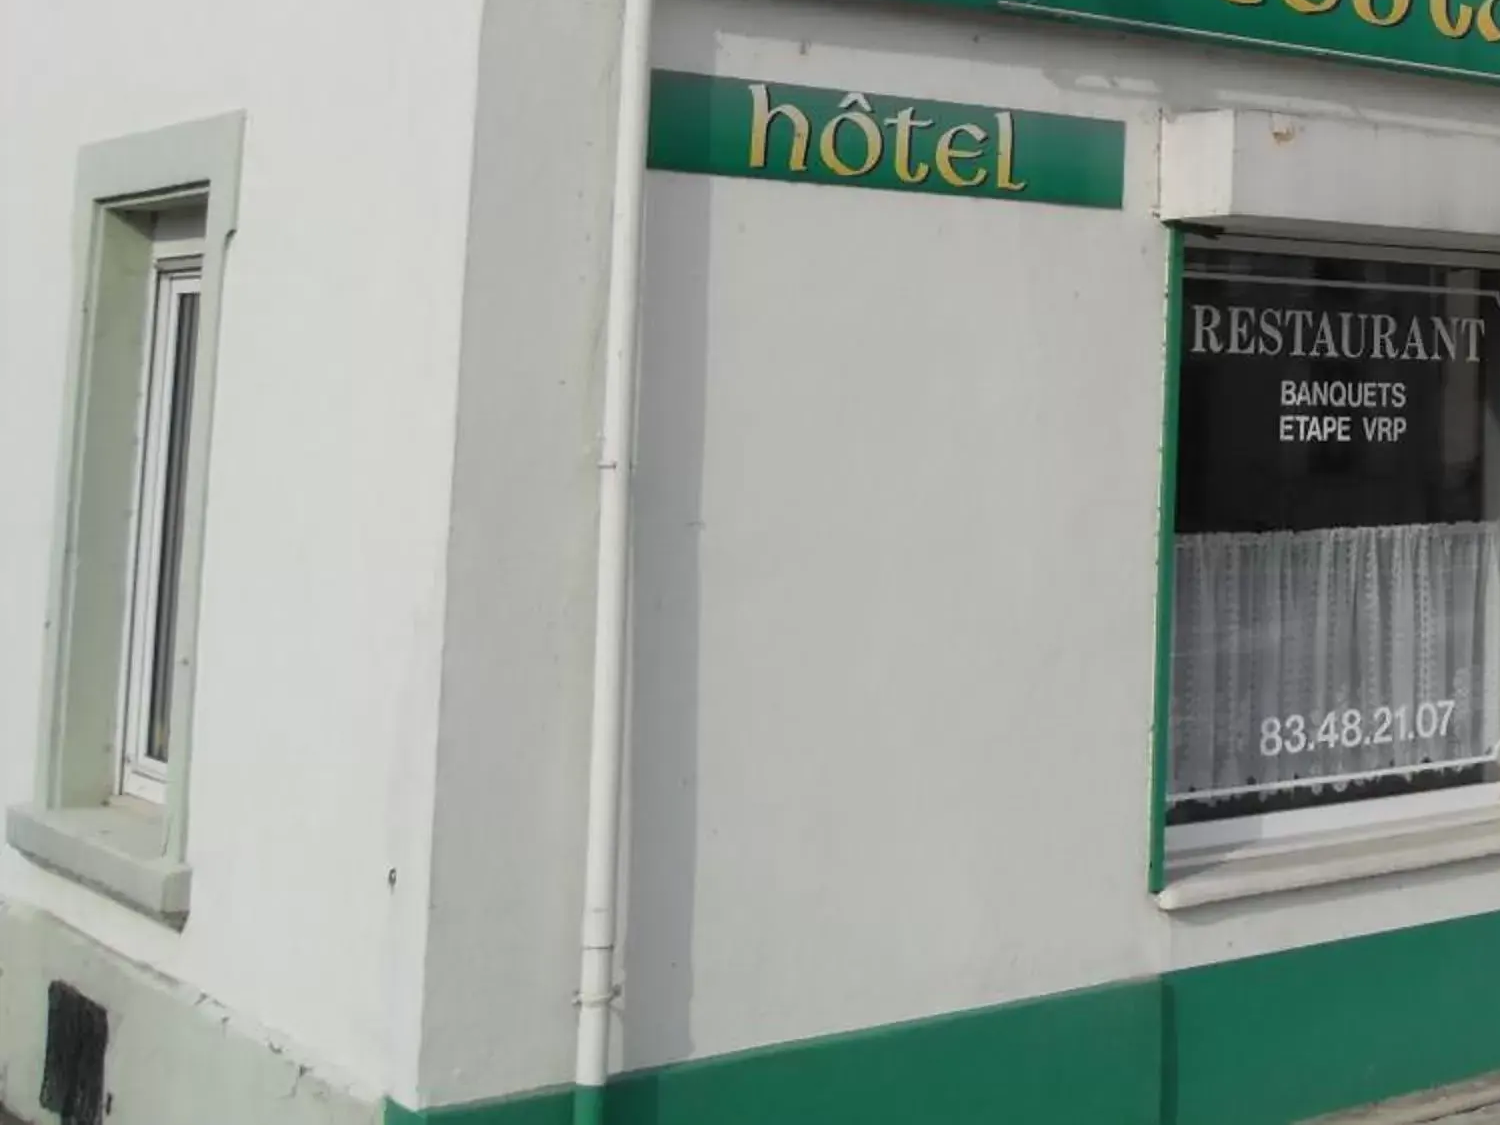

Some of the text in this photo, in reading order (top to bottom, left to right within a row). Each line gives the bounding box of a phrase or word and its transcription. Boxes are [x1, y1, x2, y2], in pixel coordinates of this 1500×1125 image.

[748, 82, 1028, 193] hôtel
[1189, 303, 1486, 364] RESTAURANT
[1279, 379, 1407, 409] BANQUETS
[1279, 415, 1408, 442] ETAPE VRP
[1259, 698, 1456, 757] 83.48.21.07
